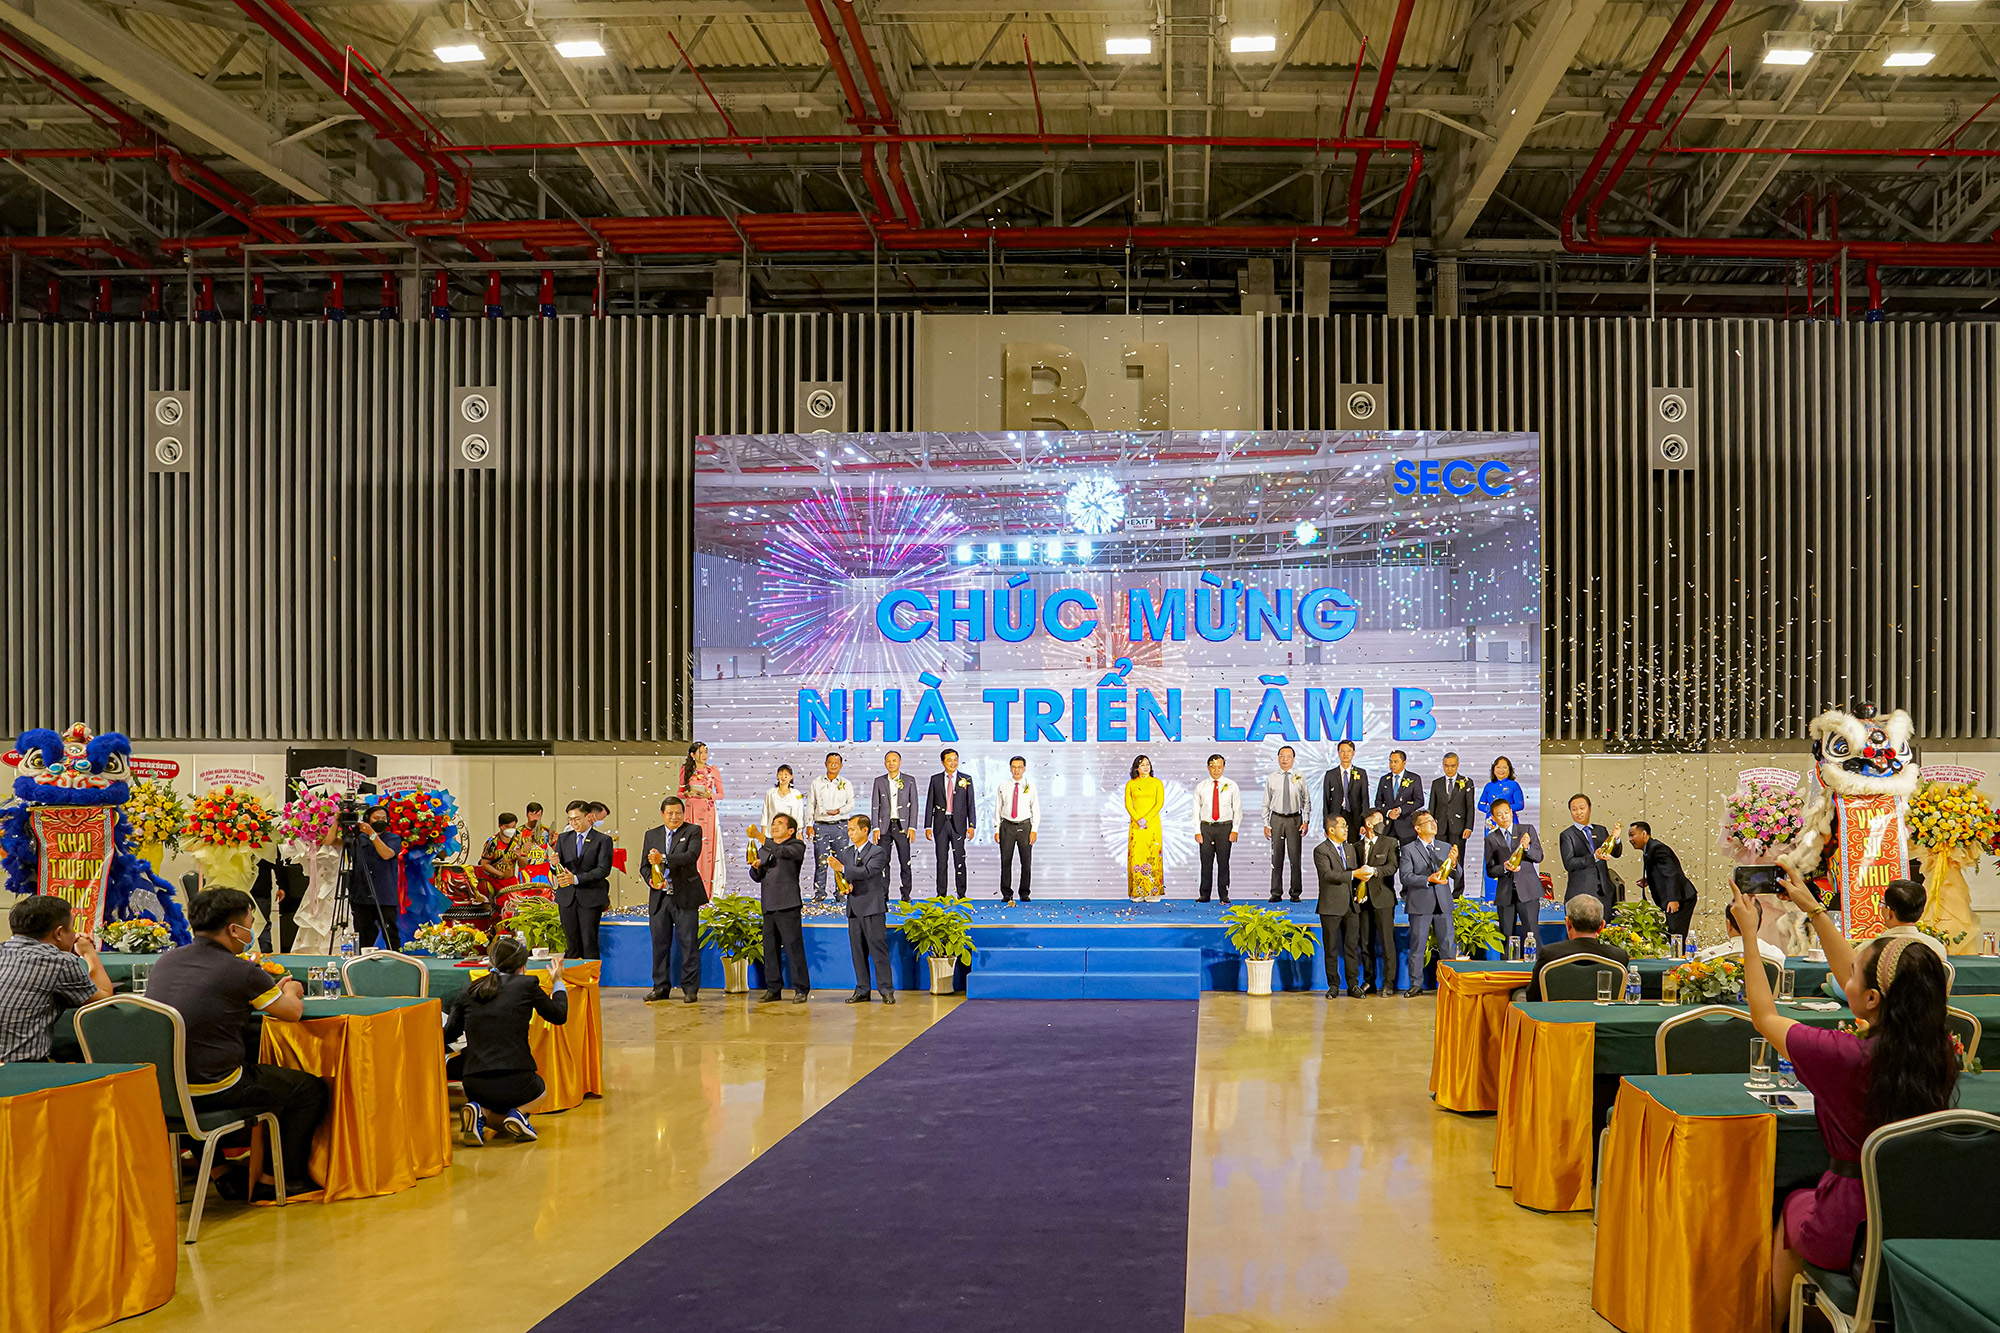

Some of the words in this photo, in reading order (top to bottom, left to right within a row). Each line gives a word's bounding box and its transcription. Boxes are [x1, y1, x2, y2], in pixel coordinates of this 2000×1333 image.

[1001, 342, 1169, 430] B1
[1393, 459, 1512, 496] SECC
[876, 571, 1100, 643] CHÚC
[1128, 569, 1358, 643] MỪNG
[797, 670, 960, 743] NHÀ
[982, 656, 1182, 743] TRIỂN
[1214, 673, 1364, 743] LÃM
[1392, 686, 1438, 743] B
[57, 832, 92, 852] KHAI
[1858, 864, 1890, 888] NHƯ
[1870, 891, 1880, 916] Ý
